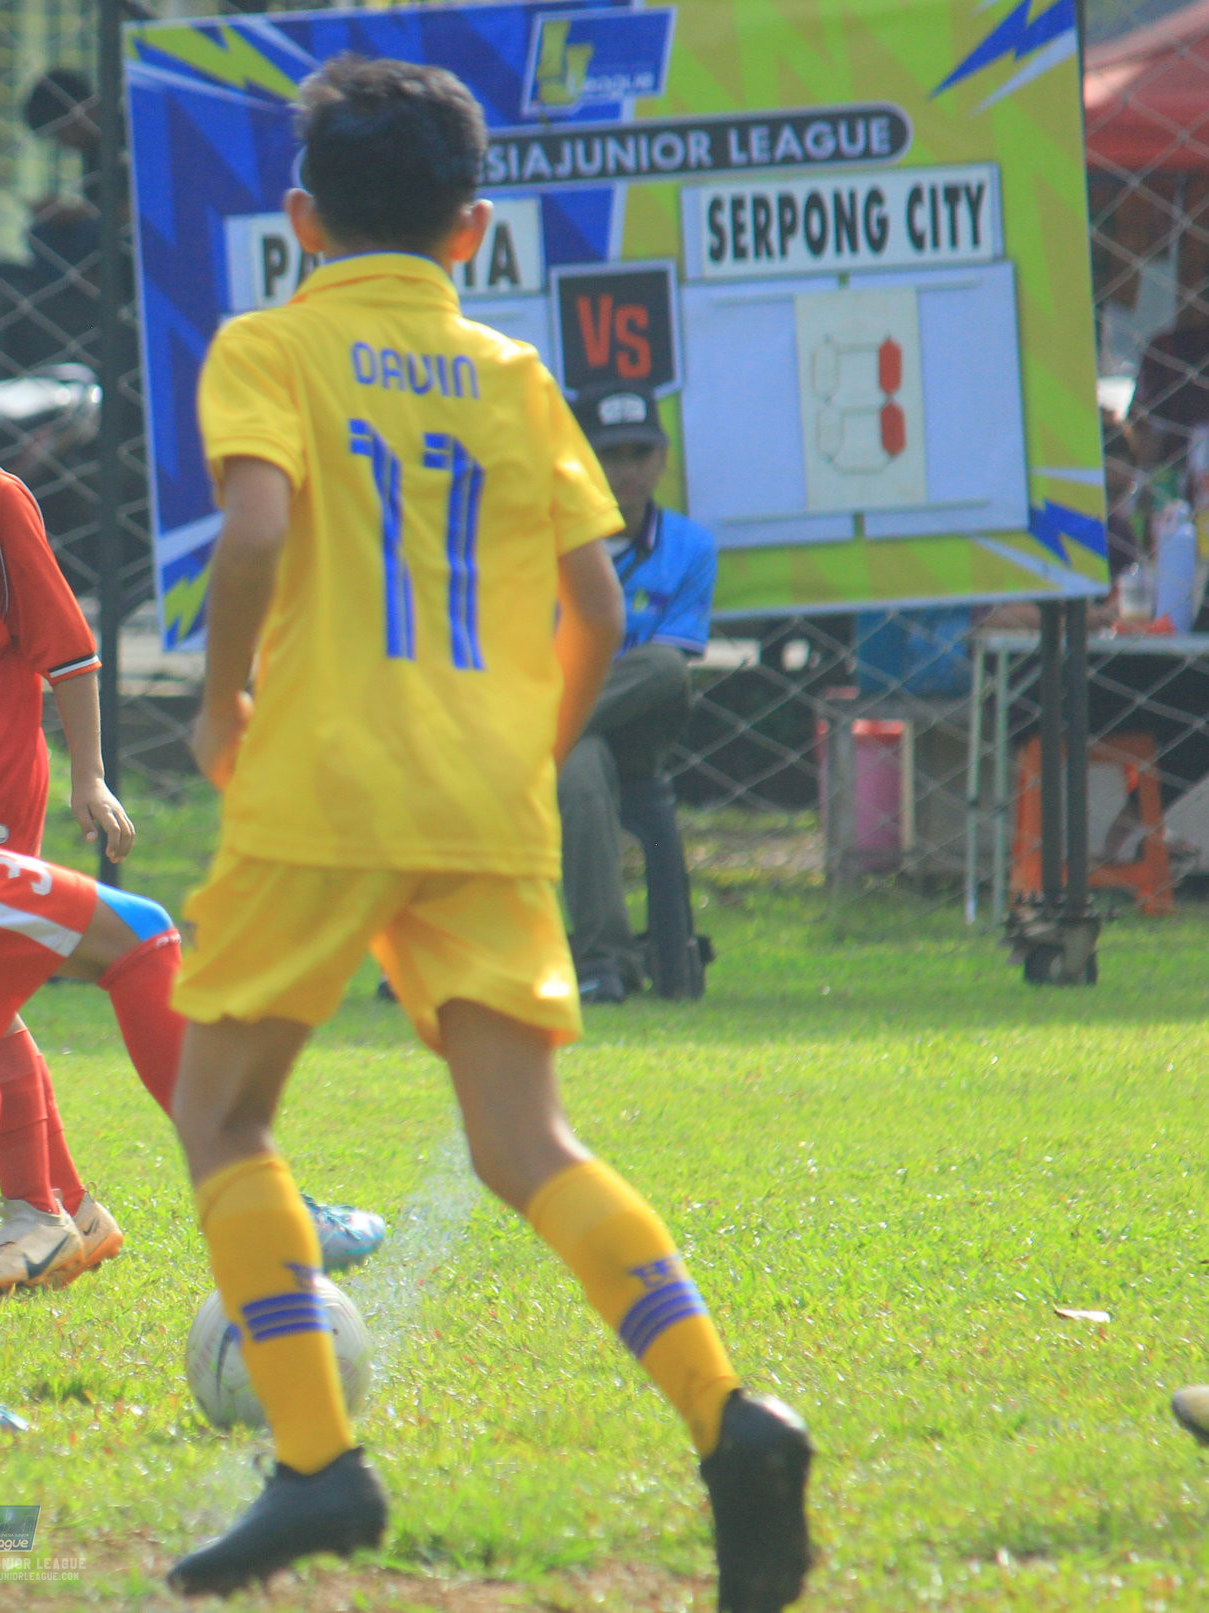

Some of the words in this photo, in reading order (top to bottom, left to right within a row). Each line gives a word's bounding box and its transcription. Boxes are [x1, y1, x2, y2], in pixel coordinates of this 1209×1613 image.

[478, 129, 712, 184] SIAJUNIOR
[727, 116, 892, 165] LEAGUE
[707, 185, 889, 263] SERPONG
[905, 181, 985, 252] CITY
[577, 294, 652, 379] VS
[347, 417, 486, 671] 11
